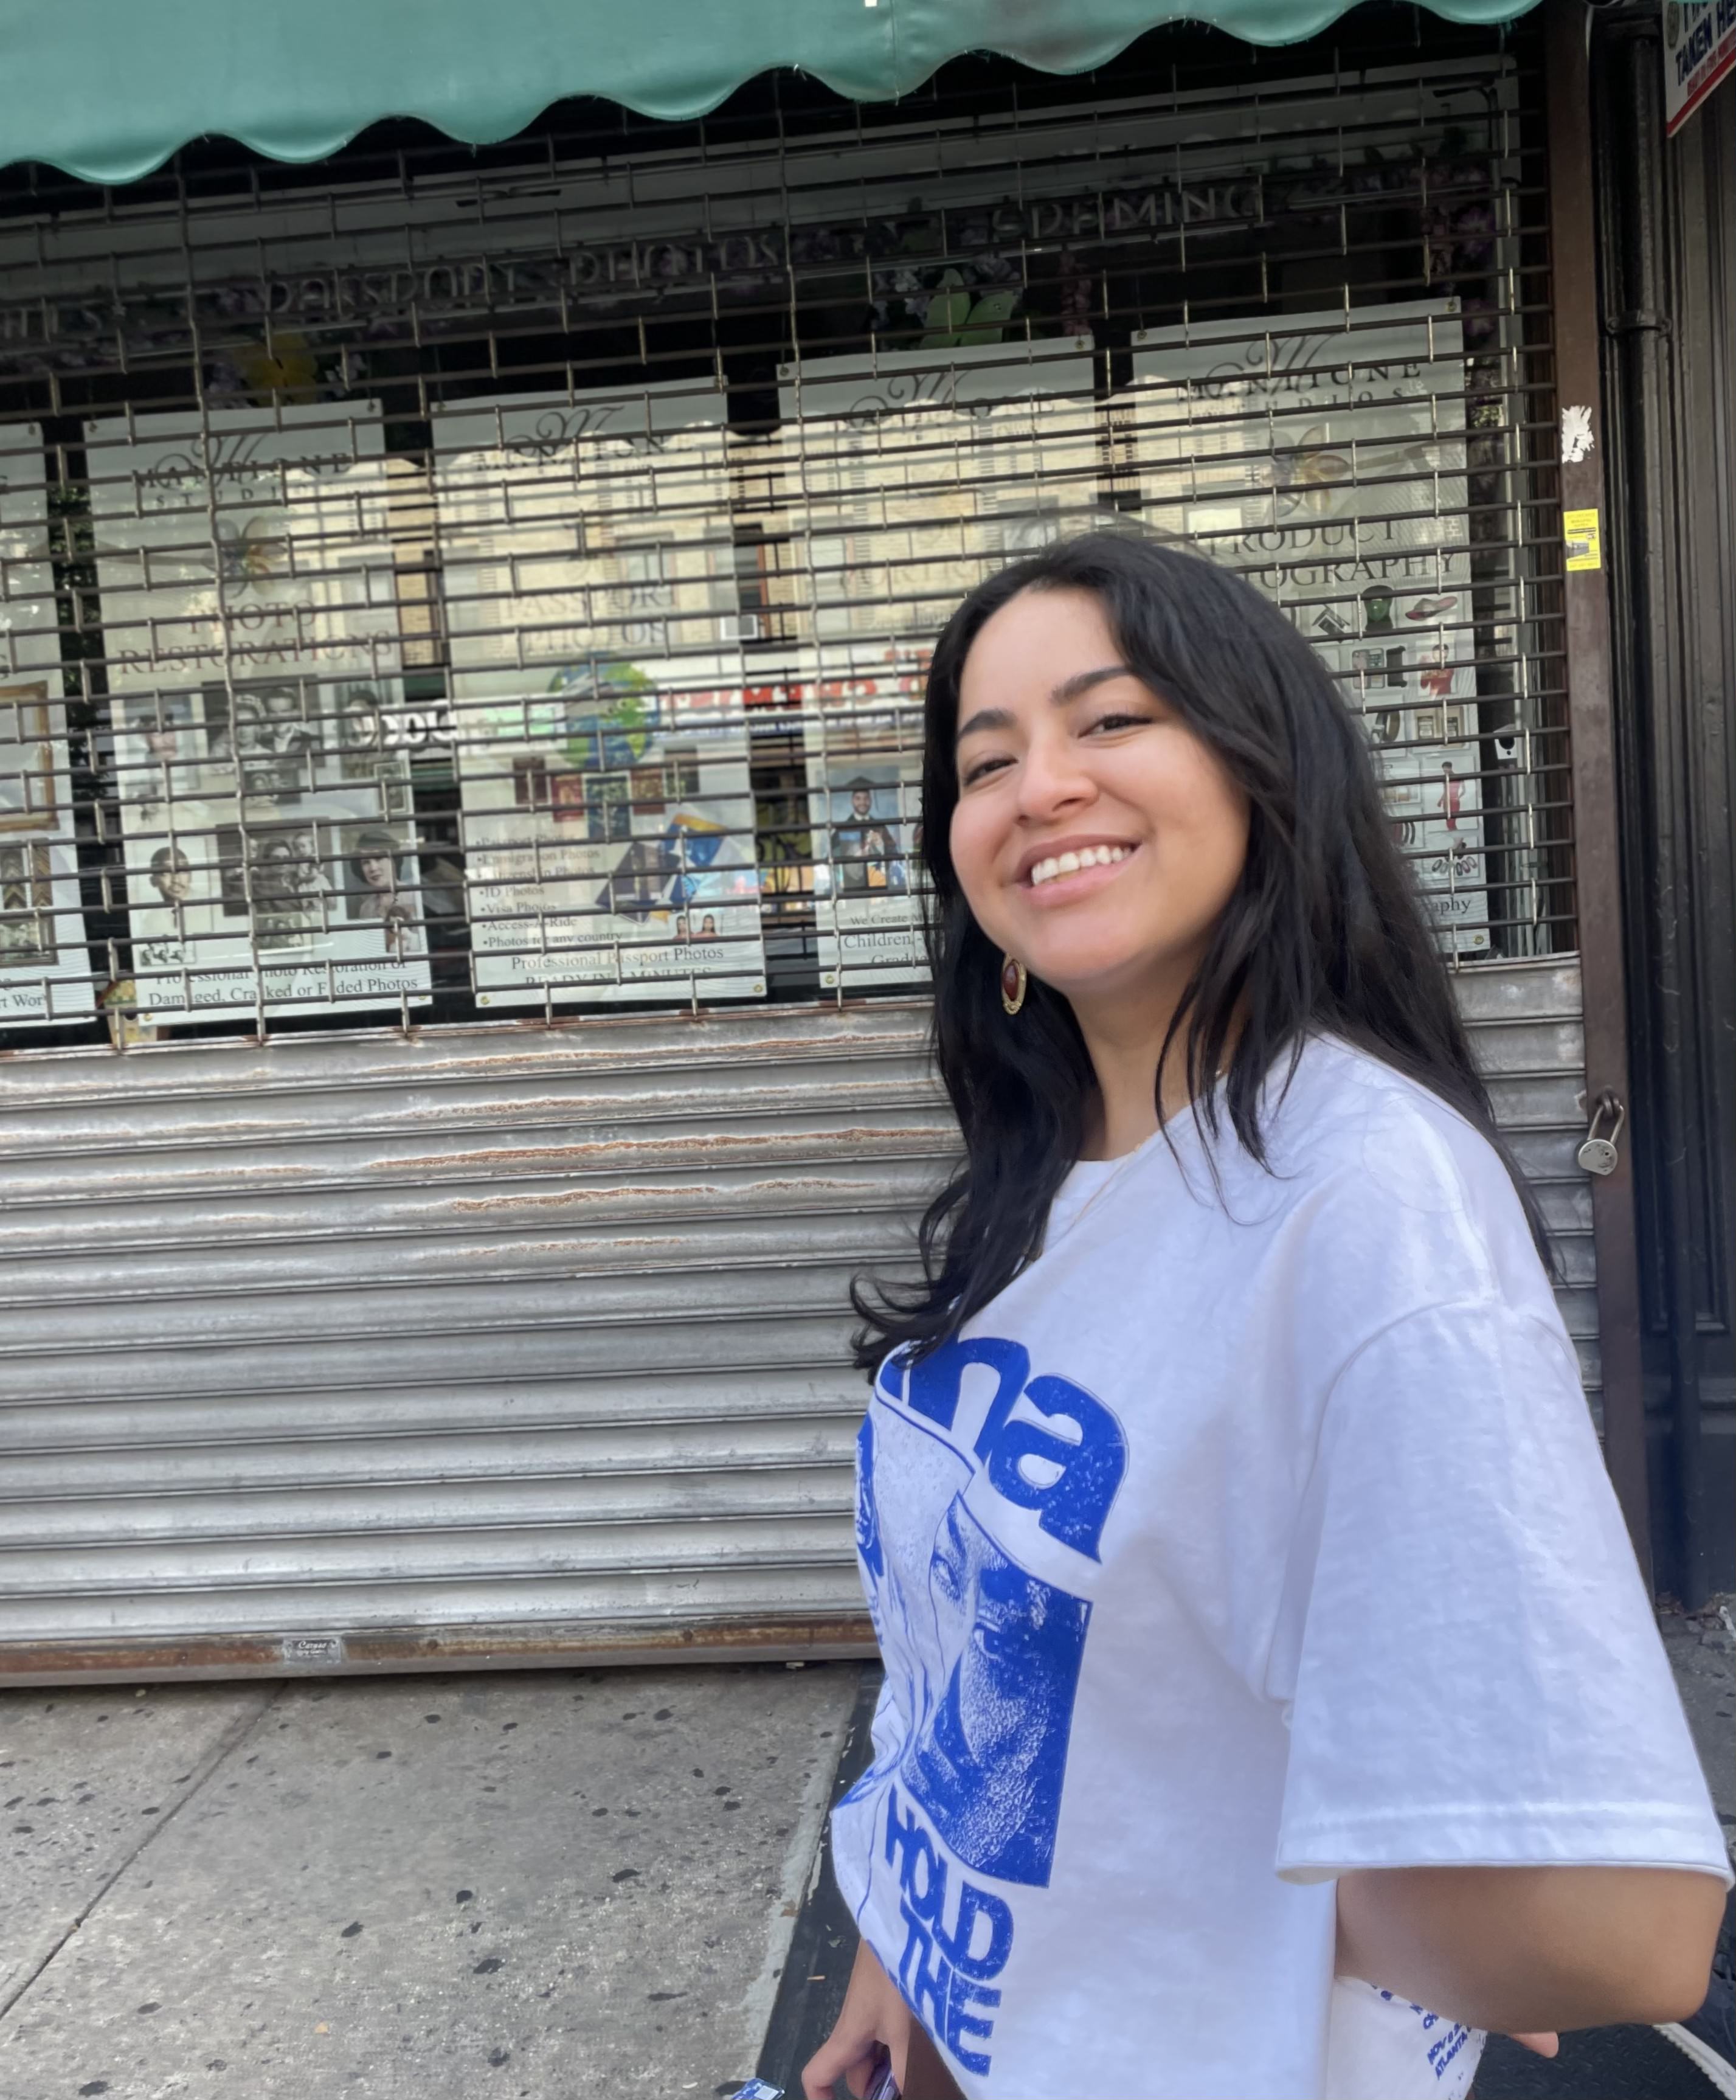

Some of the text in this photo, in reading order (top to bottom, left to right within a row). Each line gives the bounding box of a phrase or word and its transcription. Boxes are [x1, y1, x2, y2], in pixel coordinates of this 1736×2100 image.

[1675, 12, 1713, 86] TAKEN
[486, 885, 545, 898] ID Photos
[486, 901, 556, 913] Visa Photos
[850, 916, 868, 925] We
[871, 914, 908, 924] Create
[488, 936, 528, 948] Photos
[552, 934, 574, 944] any
[578, 932, 623, 944] country
[511, 952, 601, 970] Professional
[673, 946, 724, 962] Photos
[156, 972, 249, 985] Proessional
[302, 963, 387, 976] Resoration
[12, 993, 47, 1007] Wor
[148, 978, 418, 1006] Damged, Craked or Fded Photos
[885, 1781, 1015, 1981] HOLD
